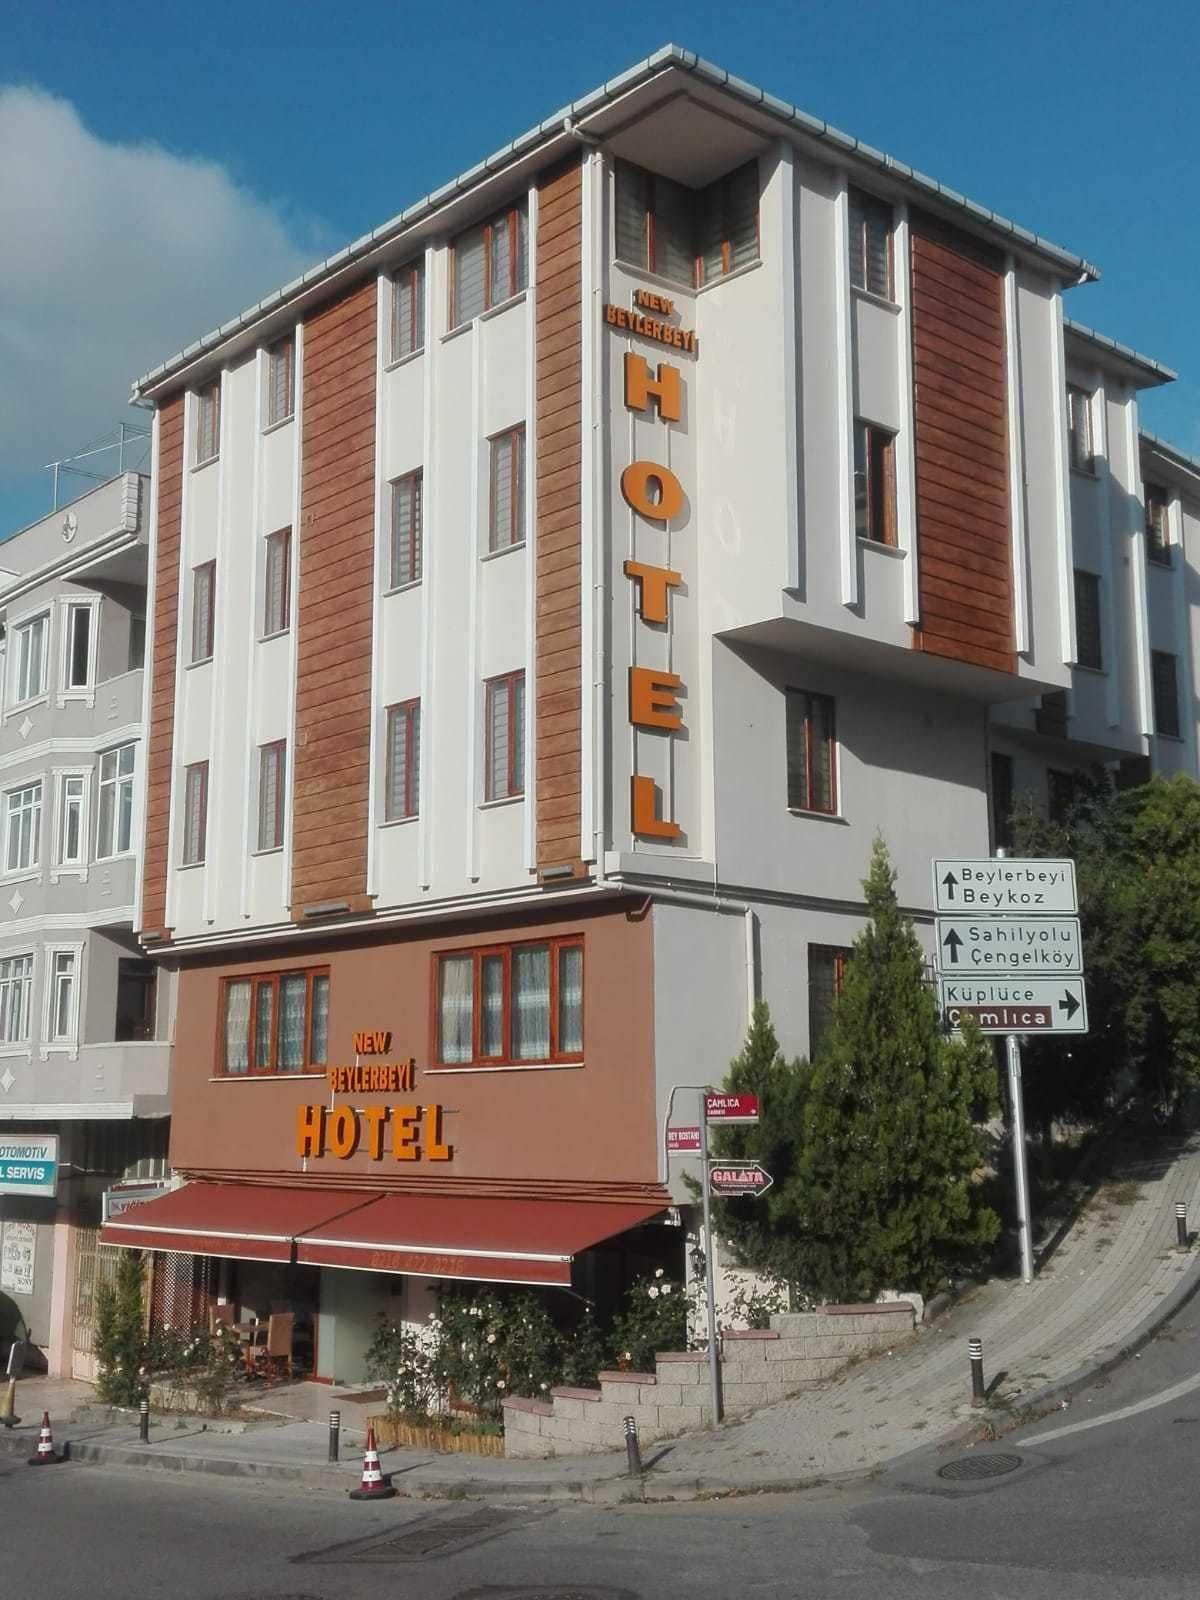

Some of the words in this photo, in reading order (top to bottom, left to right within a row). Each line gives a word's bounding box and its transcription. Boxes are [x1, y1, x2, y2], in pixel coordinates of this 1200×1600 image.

[635, 289, 674, 316] NEW
[621, 352, 682, 838] HOTEL
[962, 868, 1065, 885] Beylerbeyi
[963, 888, 1045, 907] Beykoz
[969, 927, 1071, 945] Sahilyolu
[971, 948, 1074, 967] Çengelköy
[947, 986, 1034, 1004] Küplüce
[949, 1009, 1046, 1028] Çmlıca
[352, 1031, 389, 1054] NEW
[296, 1103, 452, 1161] HOTEL
[712, 1170, 765, 1184] GALATA
